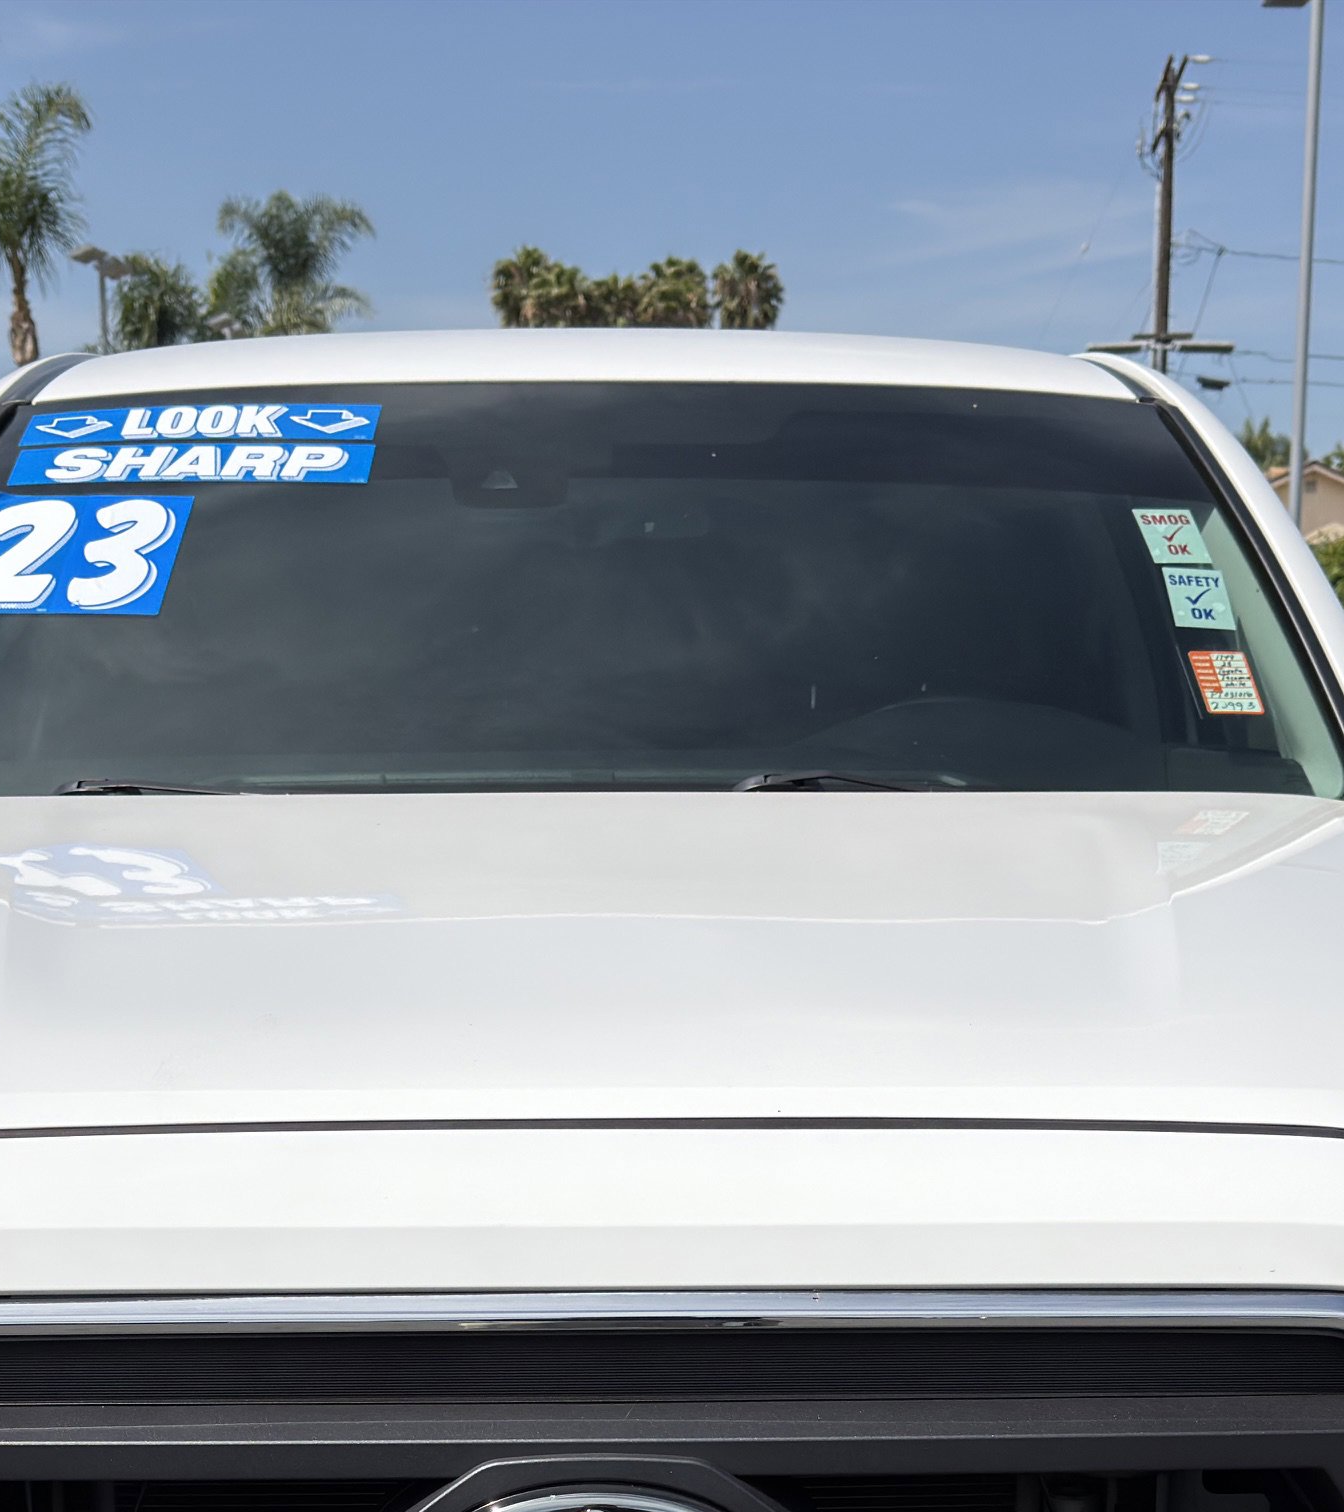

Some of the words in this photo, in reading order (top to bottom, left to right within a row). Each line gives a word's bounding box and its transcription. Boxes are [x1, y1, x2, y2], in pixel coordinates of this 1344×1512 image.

[121, 404, 289, 439] LOOK
[45, 446, 349, 482] SHARP
[1140, 514, 1191, 526] SMOG
[1167, 544, 1192, 556] OK
[1168, 574, 1220, 588] SAFETY
[1191, 608, 1216, 621] OK
